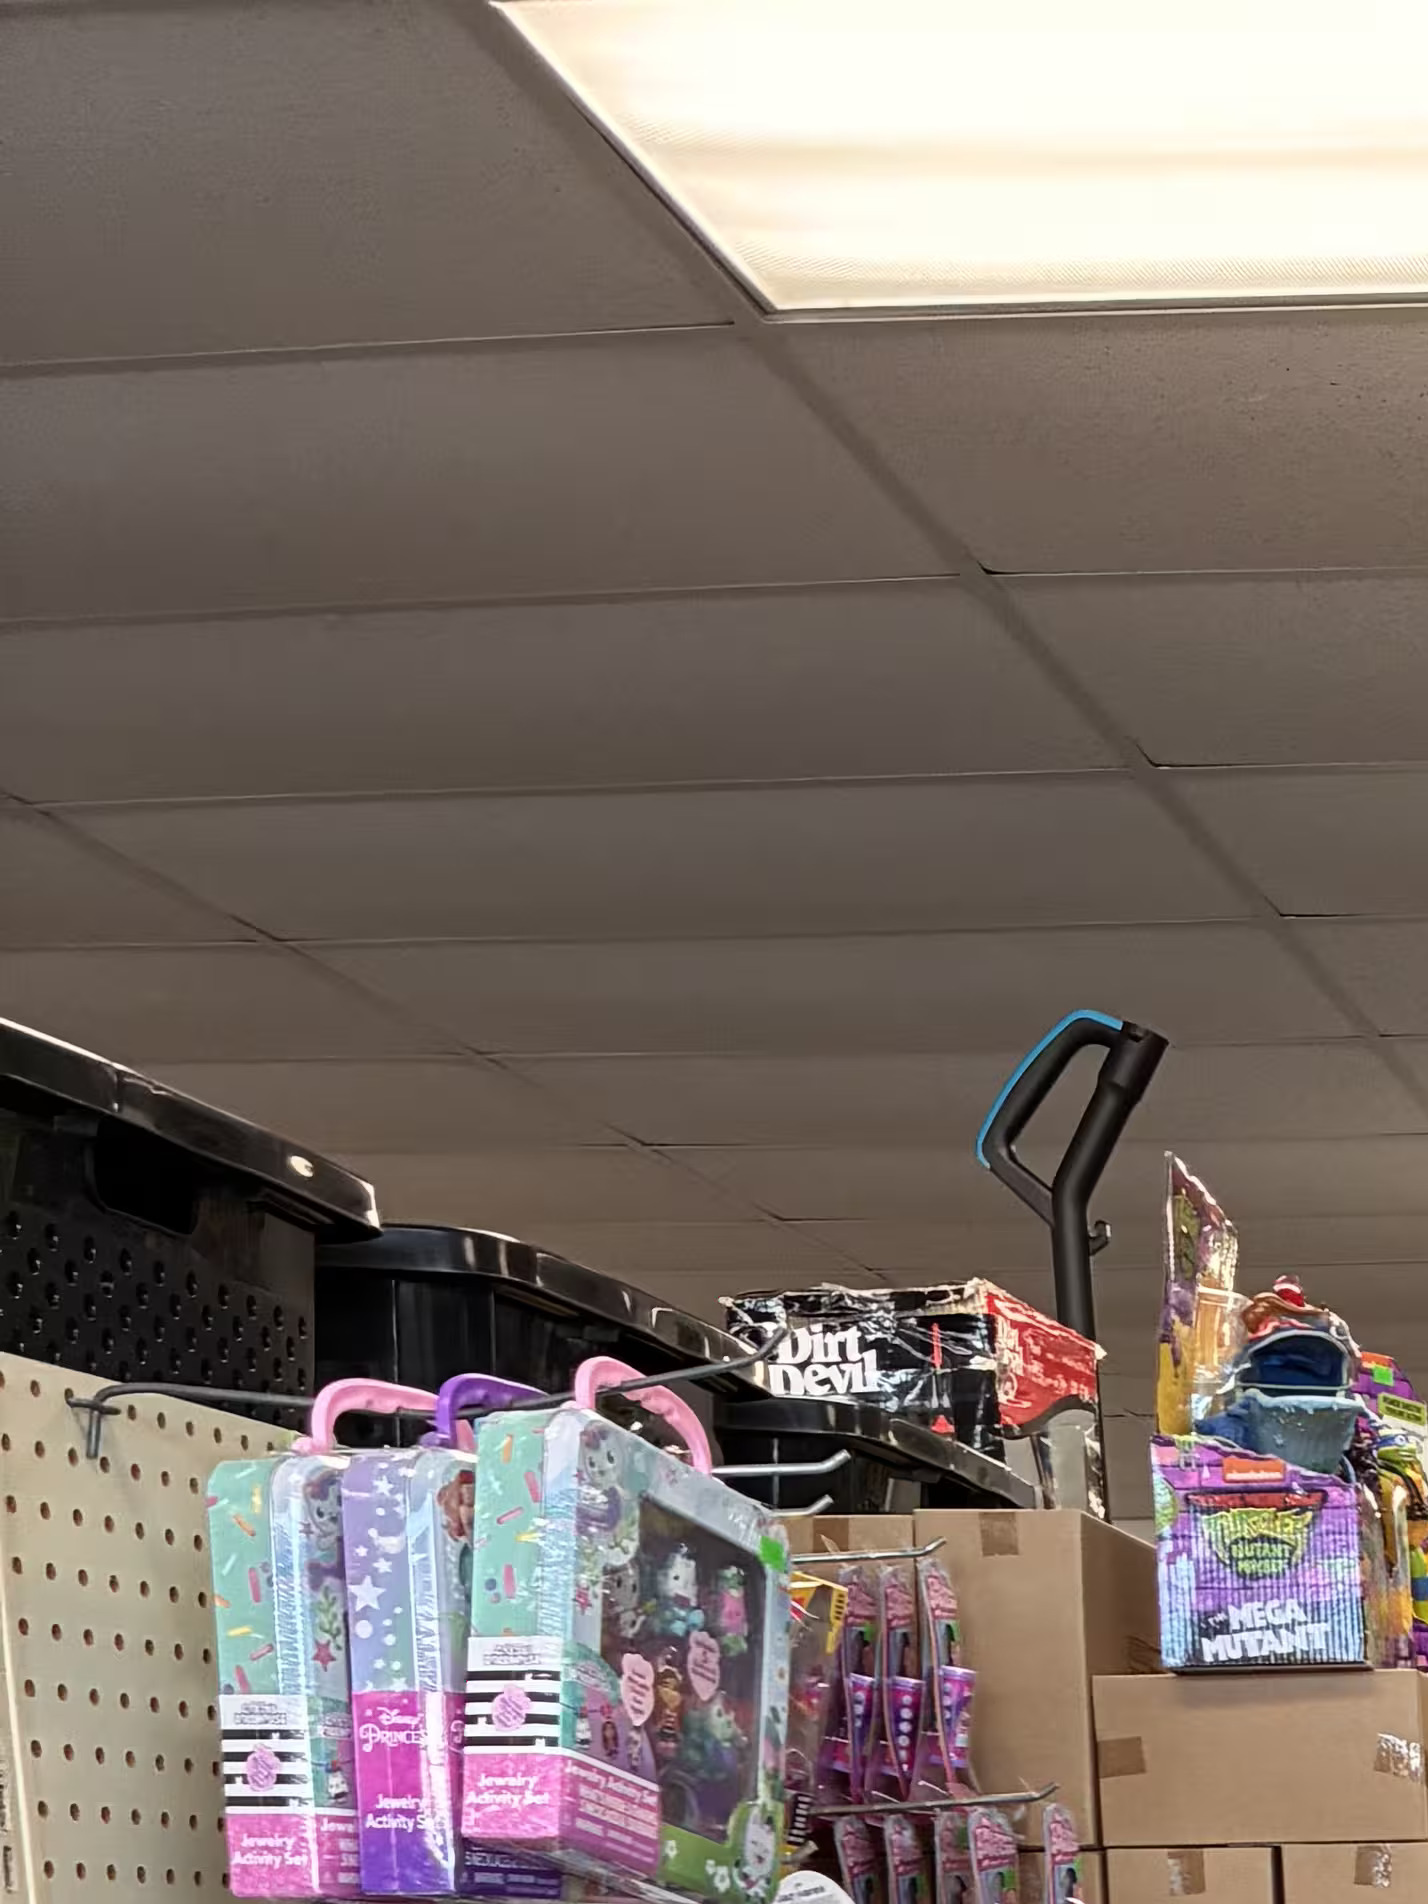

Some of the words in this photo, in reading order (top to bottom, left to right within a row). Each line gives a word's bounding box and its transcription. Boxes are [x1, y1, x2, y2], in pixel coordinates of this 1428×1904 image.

[777, 1323, 864, 1363] Dirt
[768, 1351, 880, 1396] Devil
[1229, 1599, 1306, 1630] MEGA
[1201, 1623, 1330, 1662] MUTANT
[233, 1852, 281, 1867] Activity
[240, 1834, 294, 1850] Jewelry
